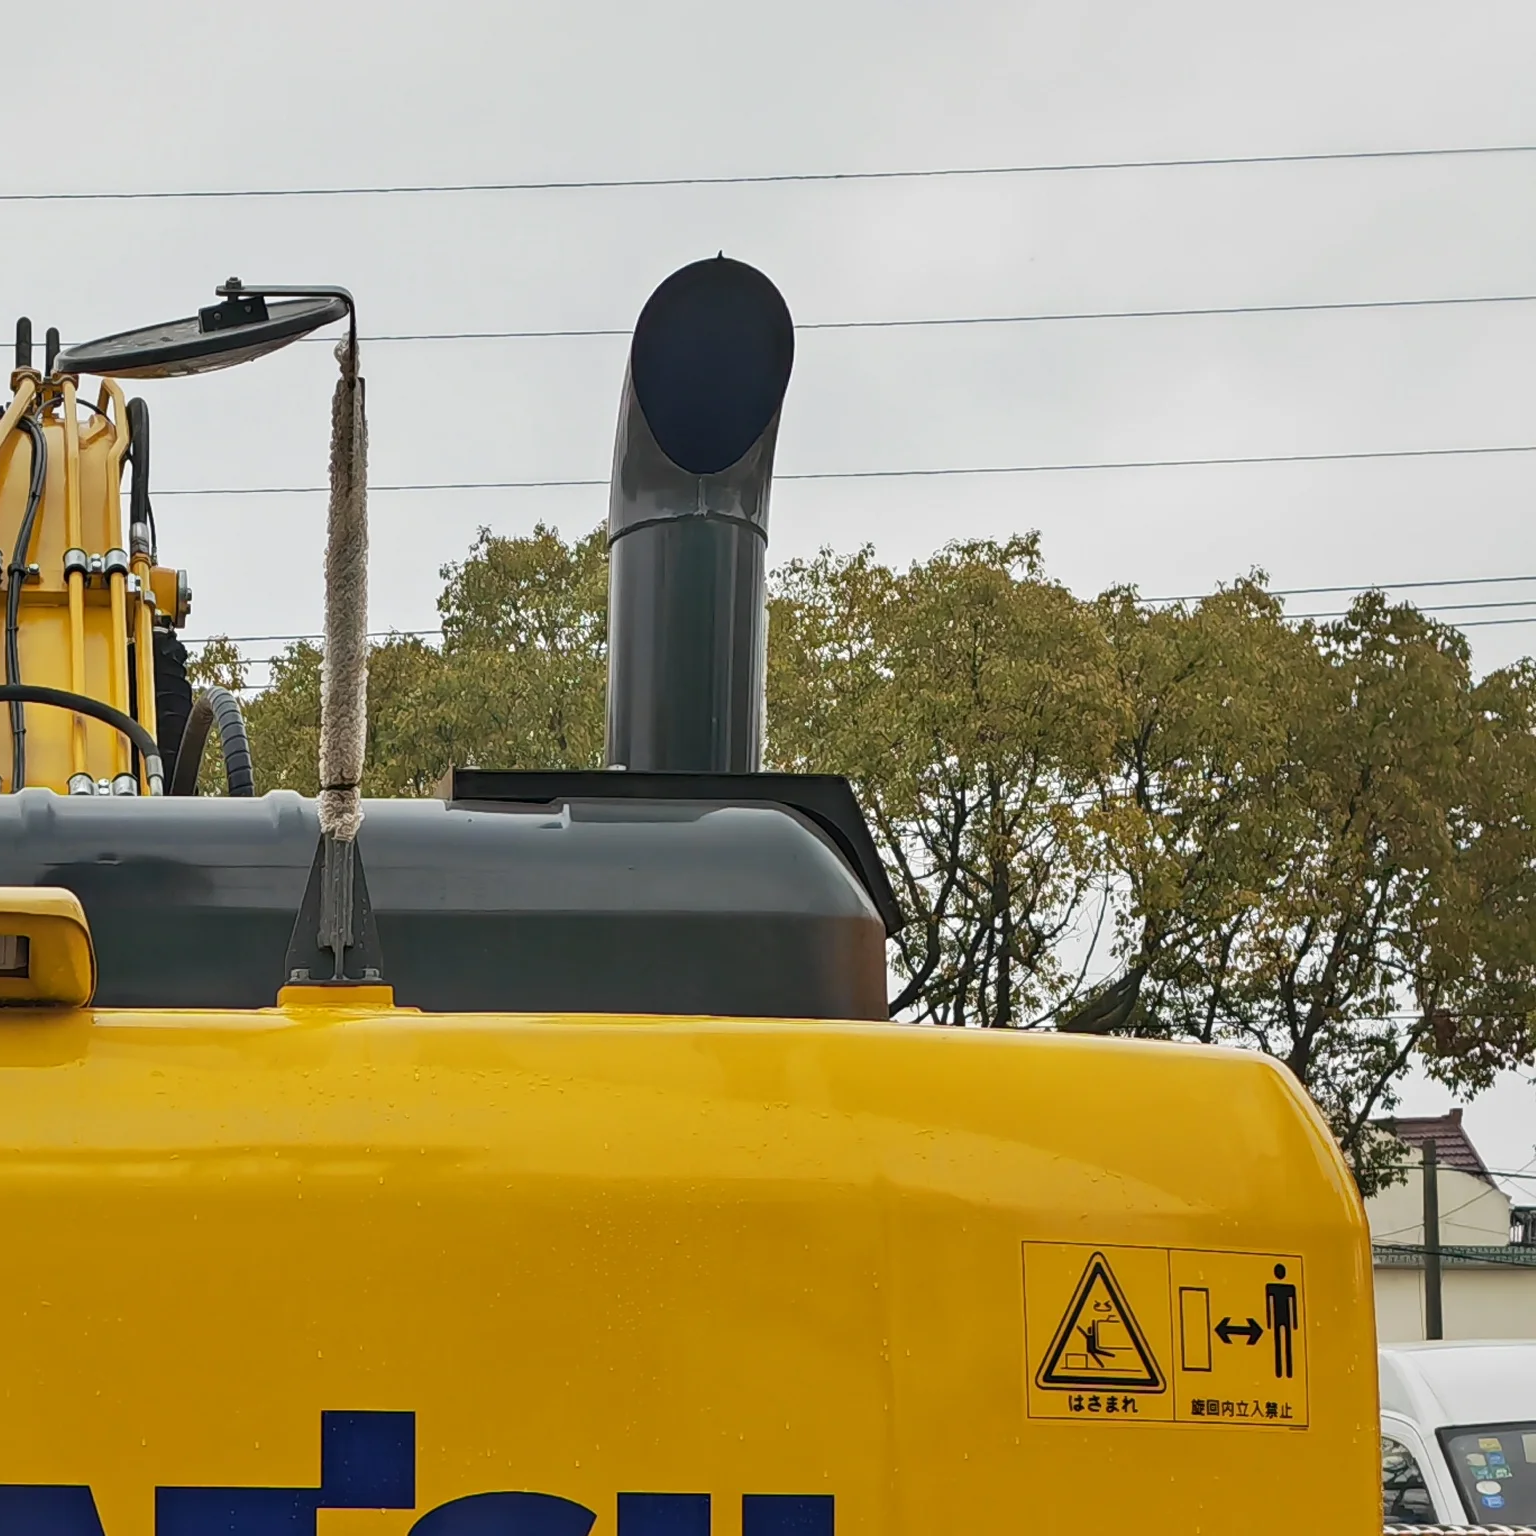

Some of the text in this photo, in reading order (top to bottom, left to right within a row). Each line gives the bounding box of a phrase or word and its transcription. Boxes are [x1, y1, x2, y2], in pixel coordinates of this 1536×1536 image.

[1068, 1395, 1139, 1413] はさまれ
[1191, 1398, 1293, 1420] 旋回内立入禁止
